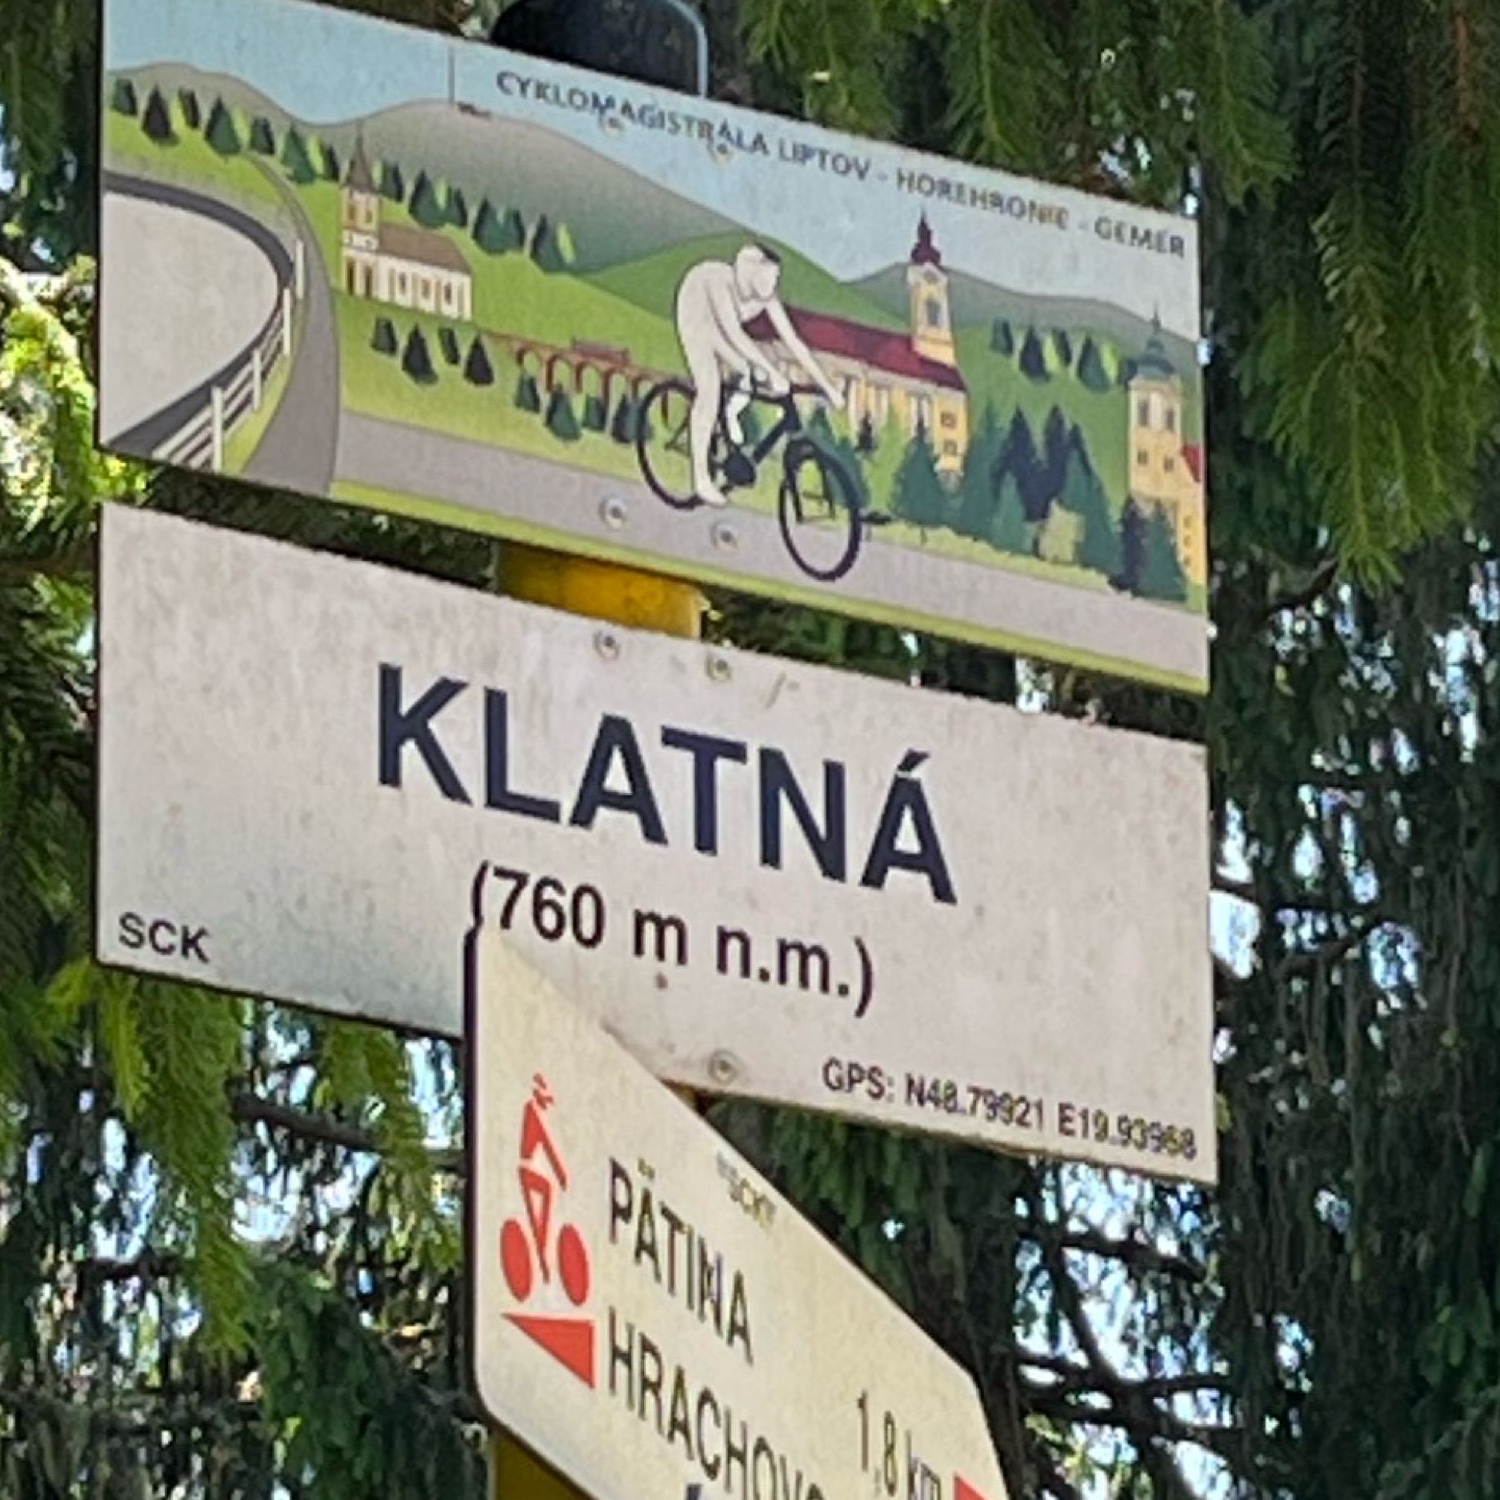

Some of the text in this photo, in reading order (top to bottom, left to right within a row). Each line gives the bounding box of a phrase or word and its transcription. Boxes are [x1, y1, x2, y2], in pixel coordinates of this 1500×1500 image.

[496, 70, 770, 156] CYKLOMAGISTRÁLA
[778, 138, 875, 182] LIPTOV
[1094, 215, 1186, 258] GEMER
[377, 661, 959, 906] KLATNÁ
[118, 911, 210, 965] SCK
[471, 859, 874, 1018] (760 m n.m.)
[822, 1056, 895, 1100] GPS:
[904, 1072, 1045, 1133] N48.79921
[608, 1155, 754, 1368] PÄTINA
[856, 1388, 898, 1499] 1,8
